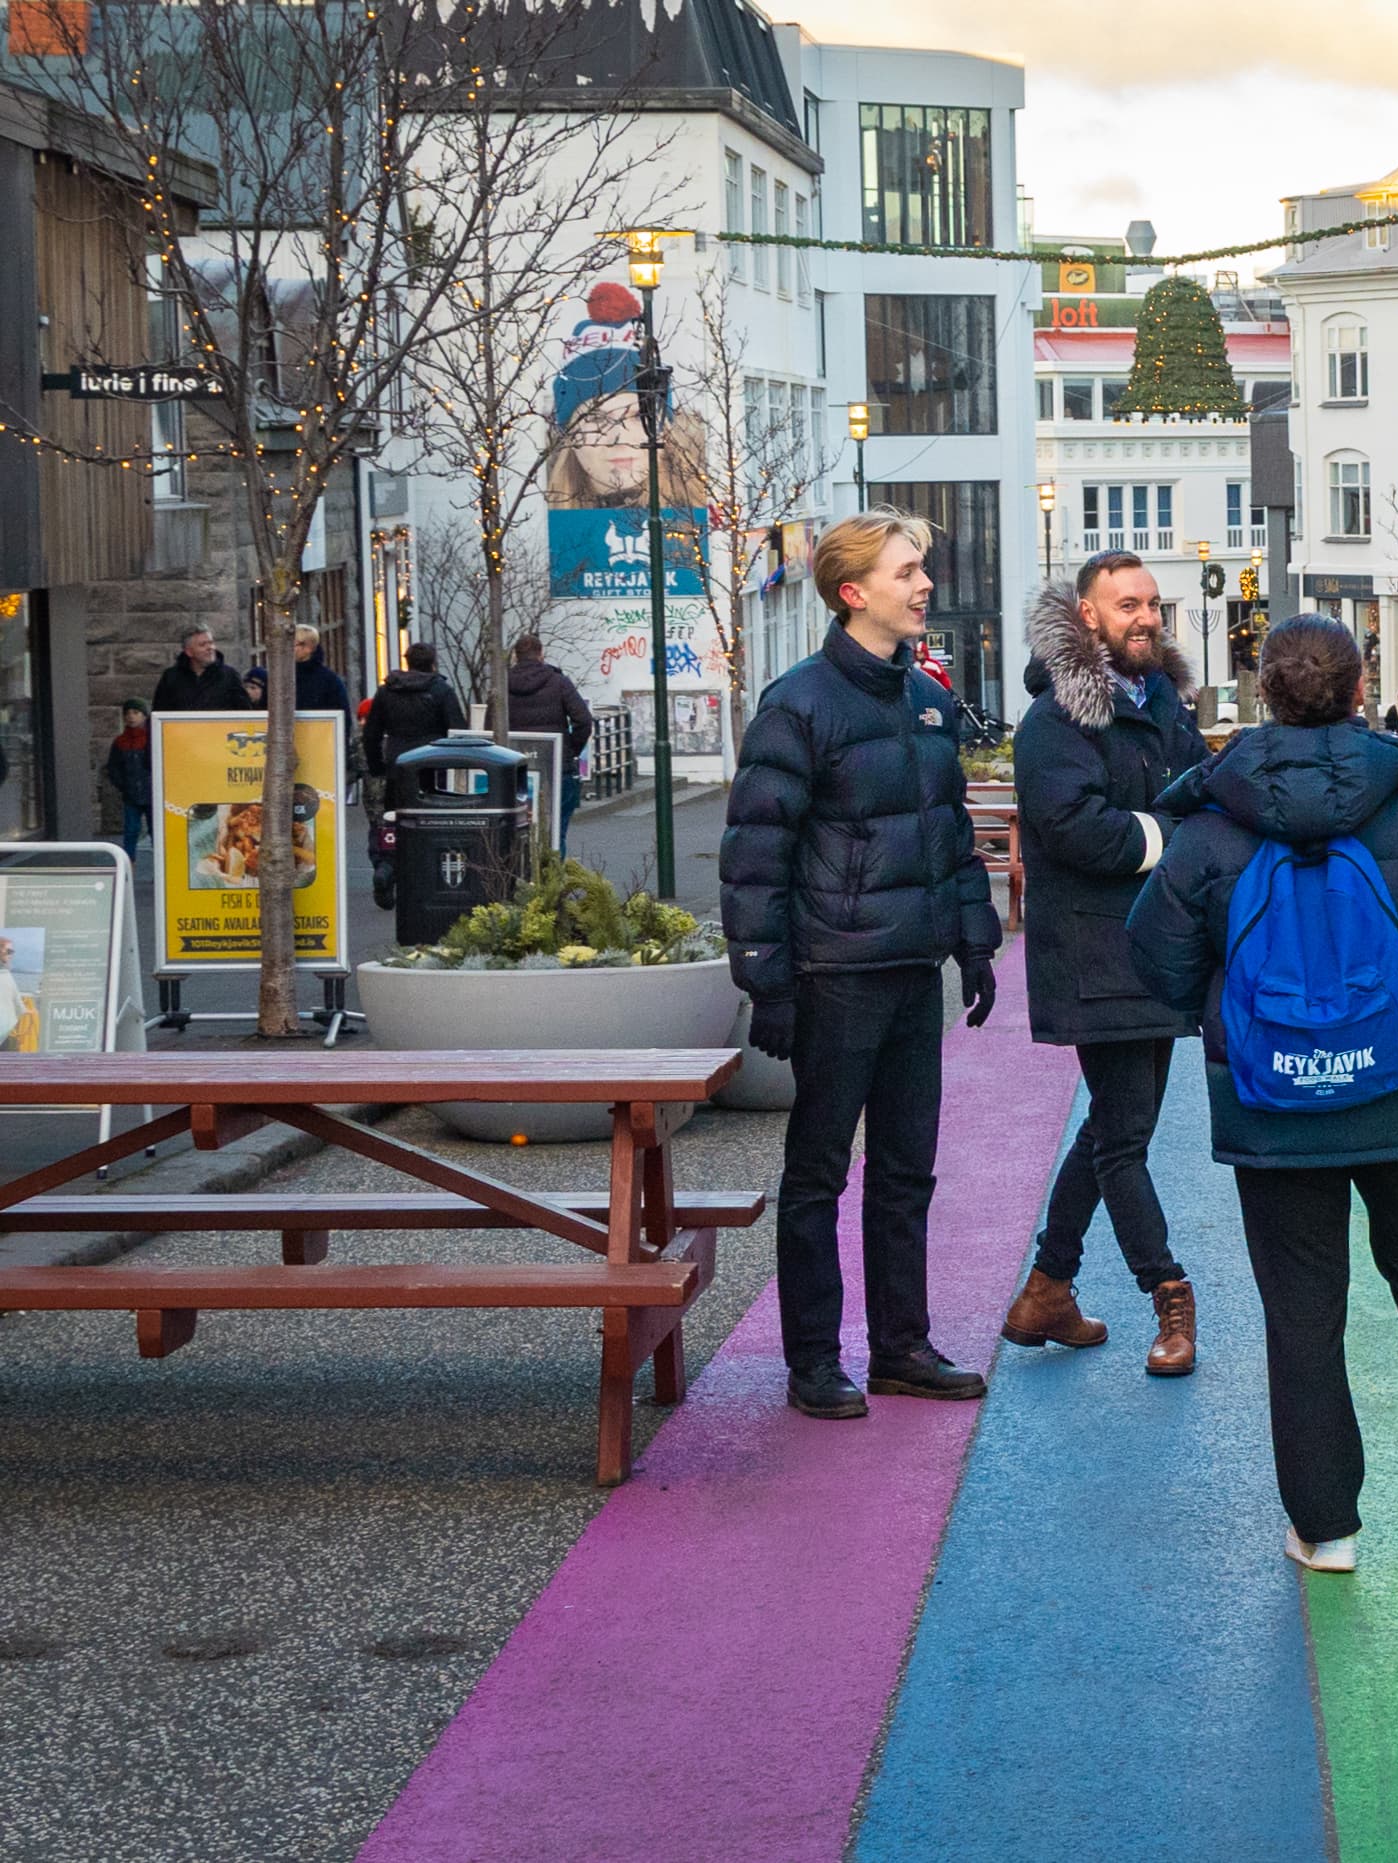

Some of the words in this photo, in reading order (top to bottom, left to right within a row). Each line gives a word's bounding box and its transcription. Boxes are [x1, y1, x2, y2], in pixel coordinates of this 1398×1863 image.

[1051, 298, 1098, 328] loft
[151, 372, 198, 391] fine
[583, 571, 678, 588] REYKJAK
[626, 588, 671, 597] STOE
[227, 766, 264, 785] REYKJAV
[221, 893, 242, 909] FISH
[177, 917, 220, 931] SEATING
[223, 916, 262, 931] AVAILA
[294, 915, 330, 930] STAIRS
[53, 1004, 97, 1021] MJÚK
[1272, 1046, 1376, 1076] REYKJAVIK
